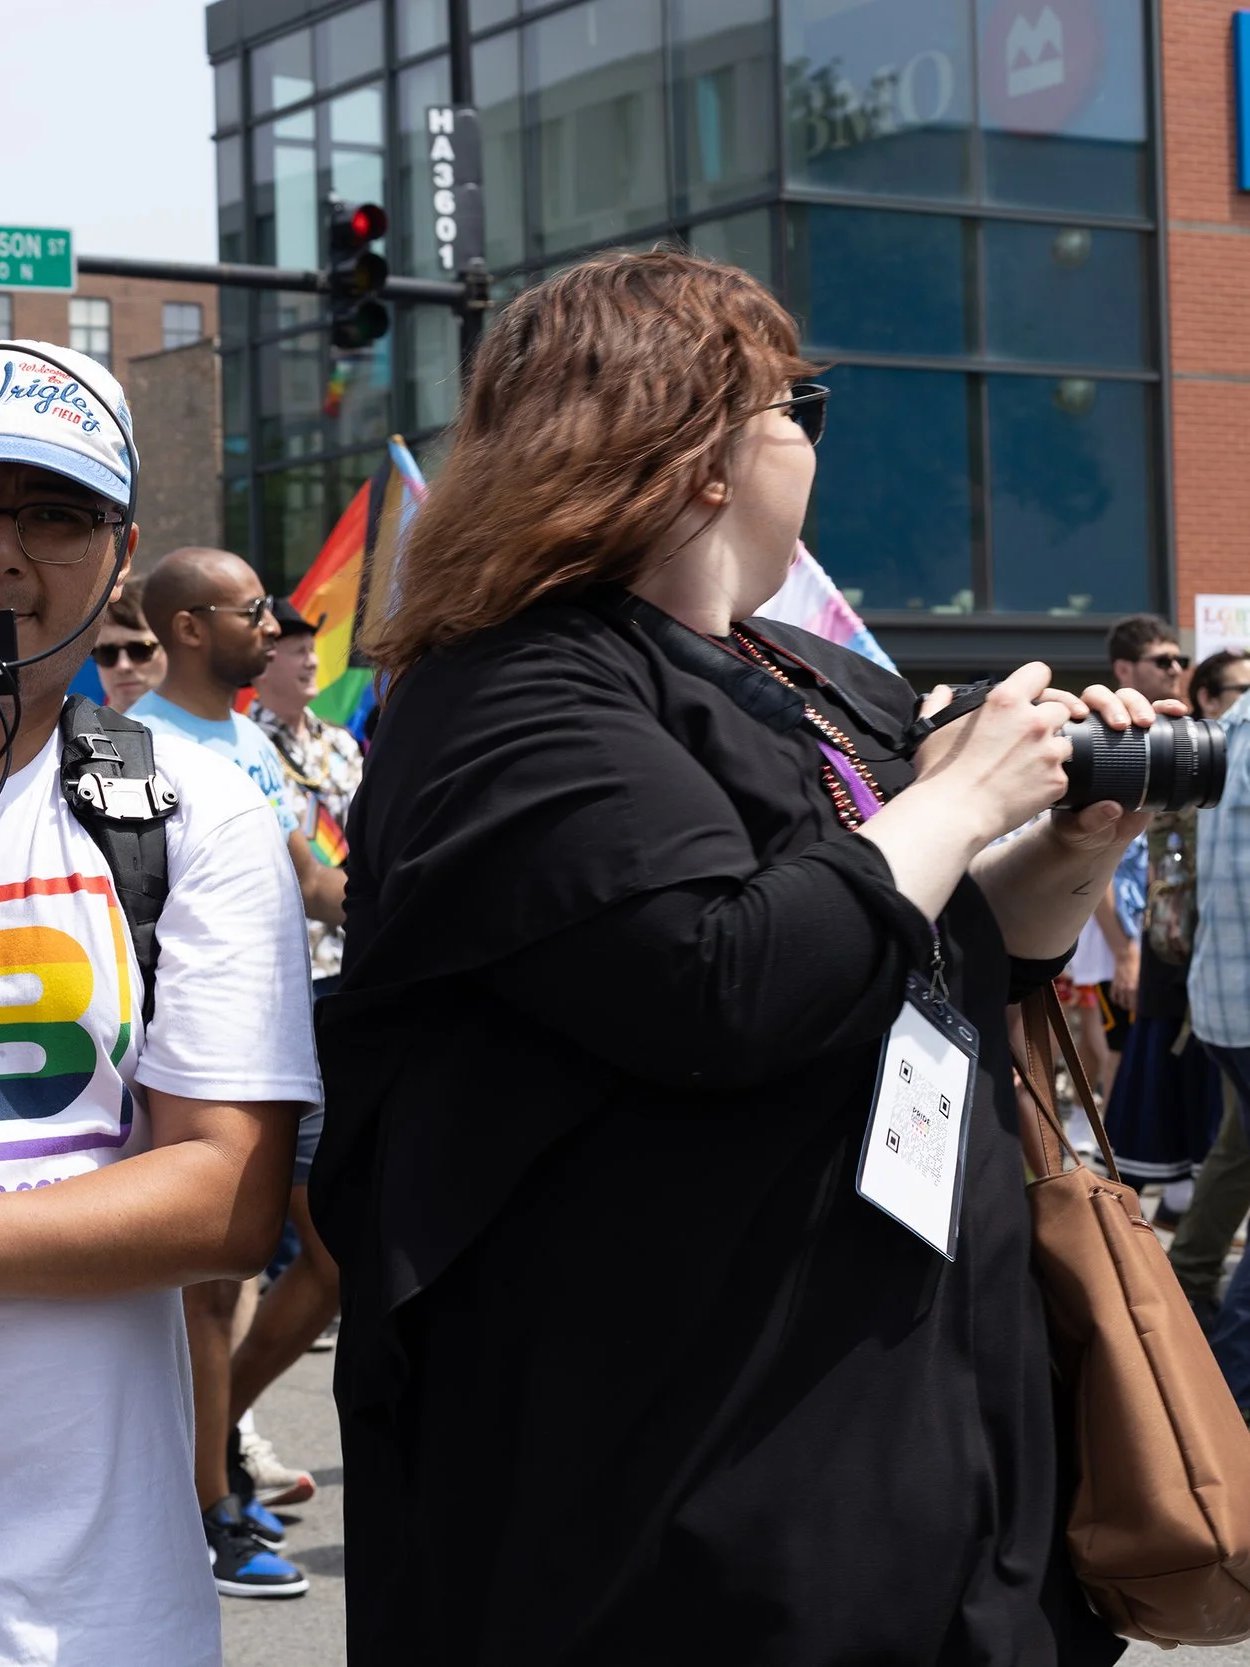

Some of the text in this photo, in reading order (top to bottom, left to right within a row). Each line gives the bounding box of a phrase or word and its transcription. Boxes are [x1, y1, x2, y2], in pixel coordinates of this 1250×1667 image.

[428, 108, 457, 269] HA3601
[47, 237, 67, 256] ST
[20, 263, 34, 281] N
[52, 406, 82, 425] FIELD
